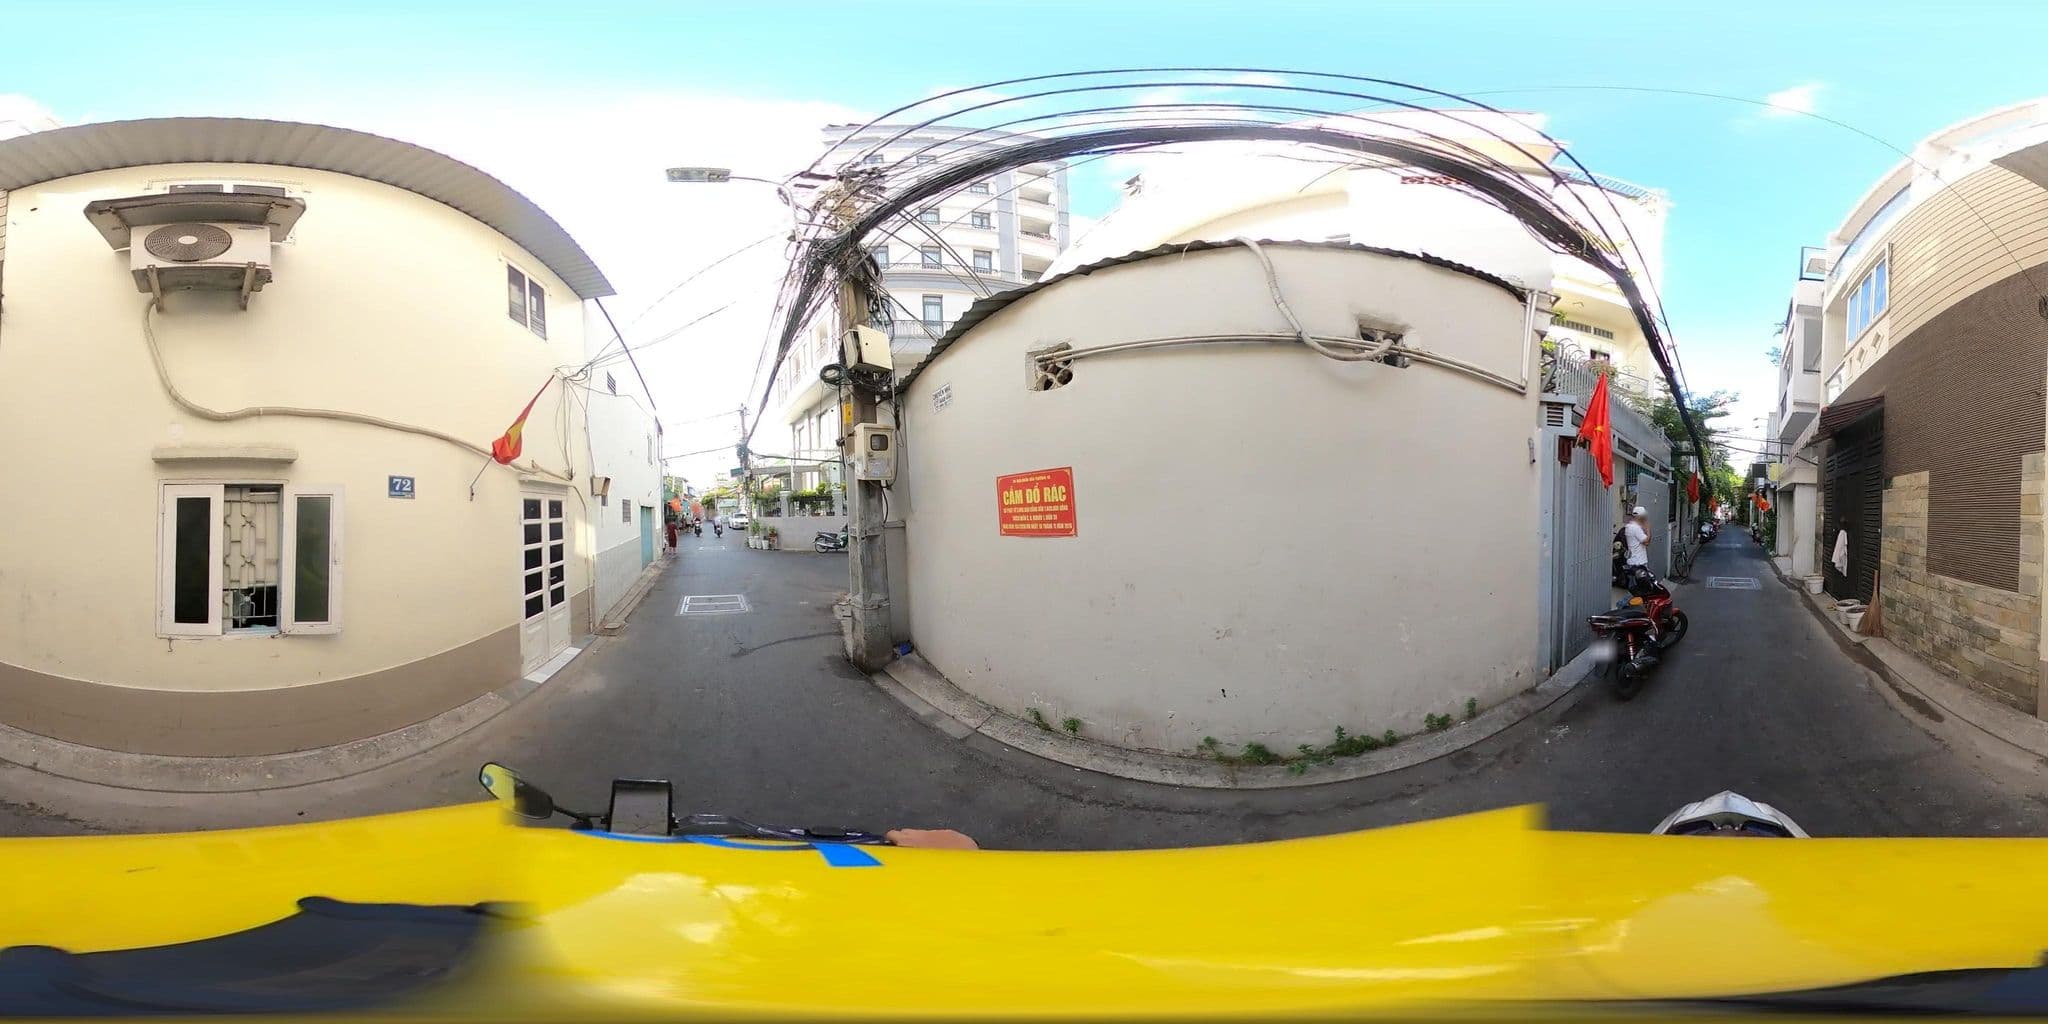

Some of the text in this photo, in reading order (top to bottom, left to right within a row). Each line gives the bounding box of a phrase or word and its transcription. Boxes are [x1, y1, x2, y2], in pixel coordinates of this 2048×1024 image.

[393, 478, 412, 491] 72
[1003, 483, 1067, 505] CẤM ĐỔ RÁC
